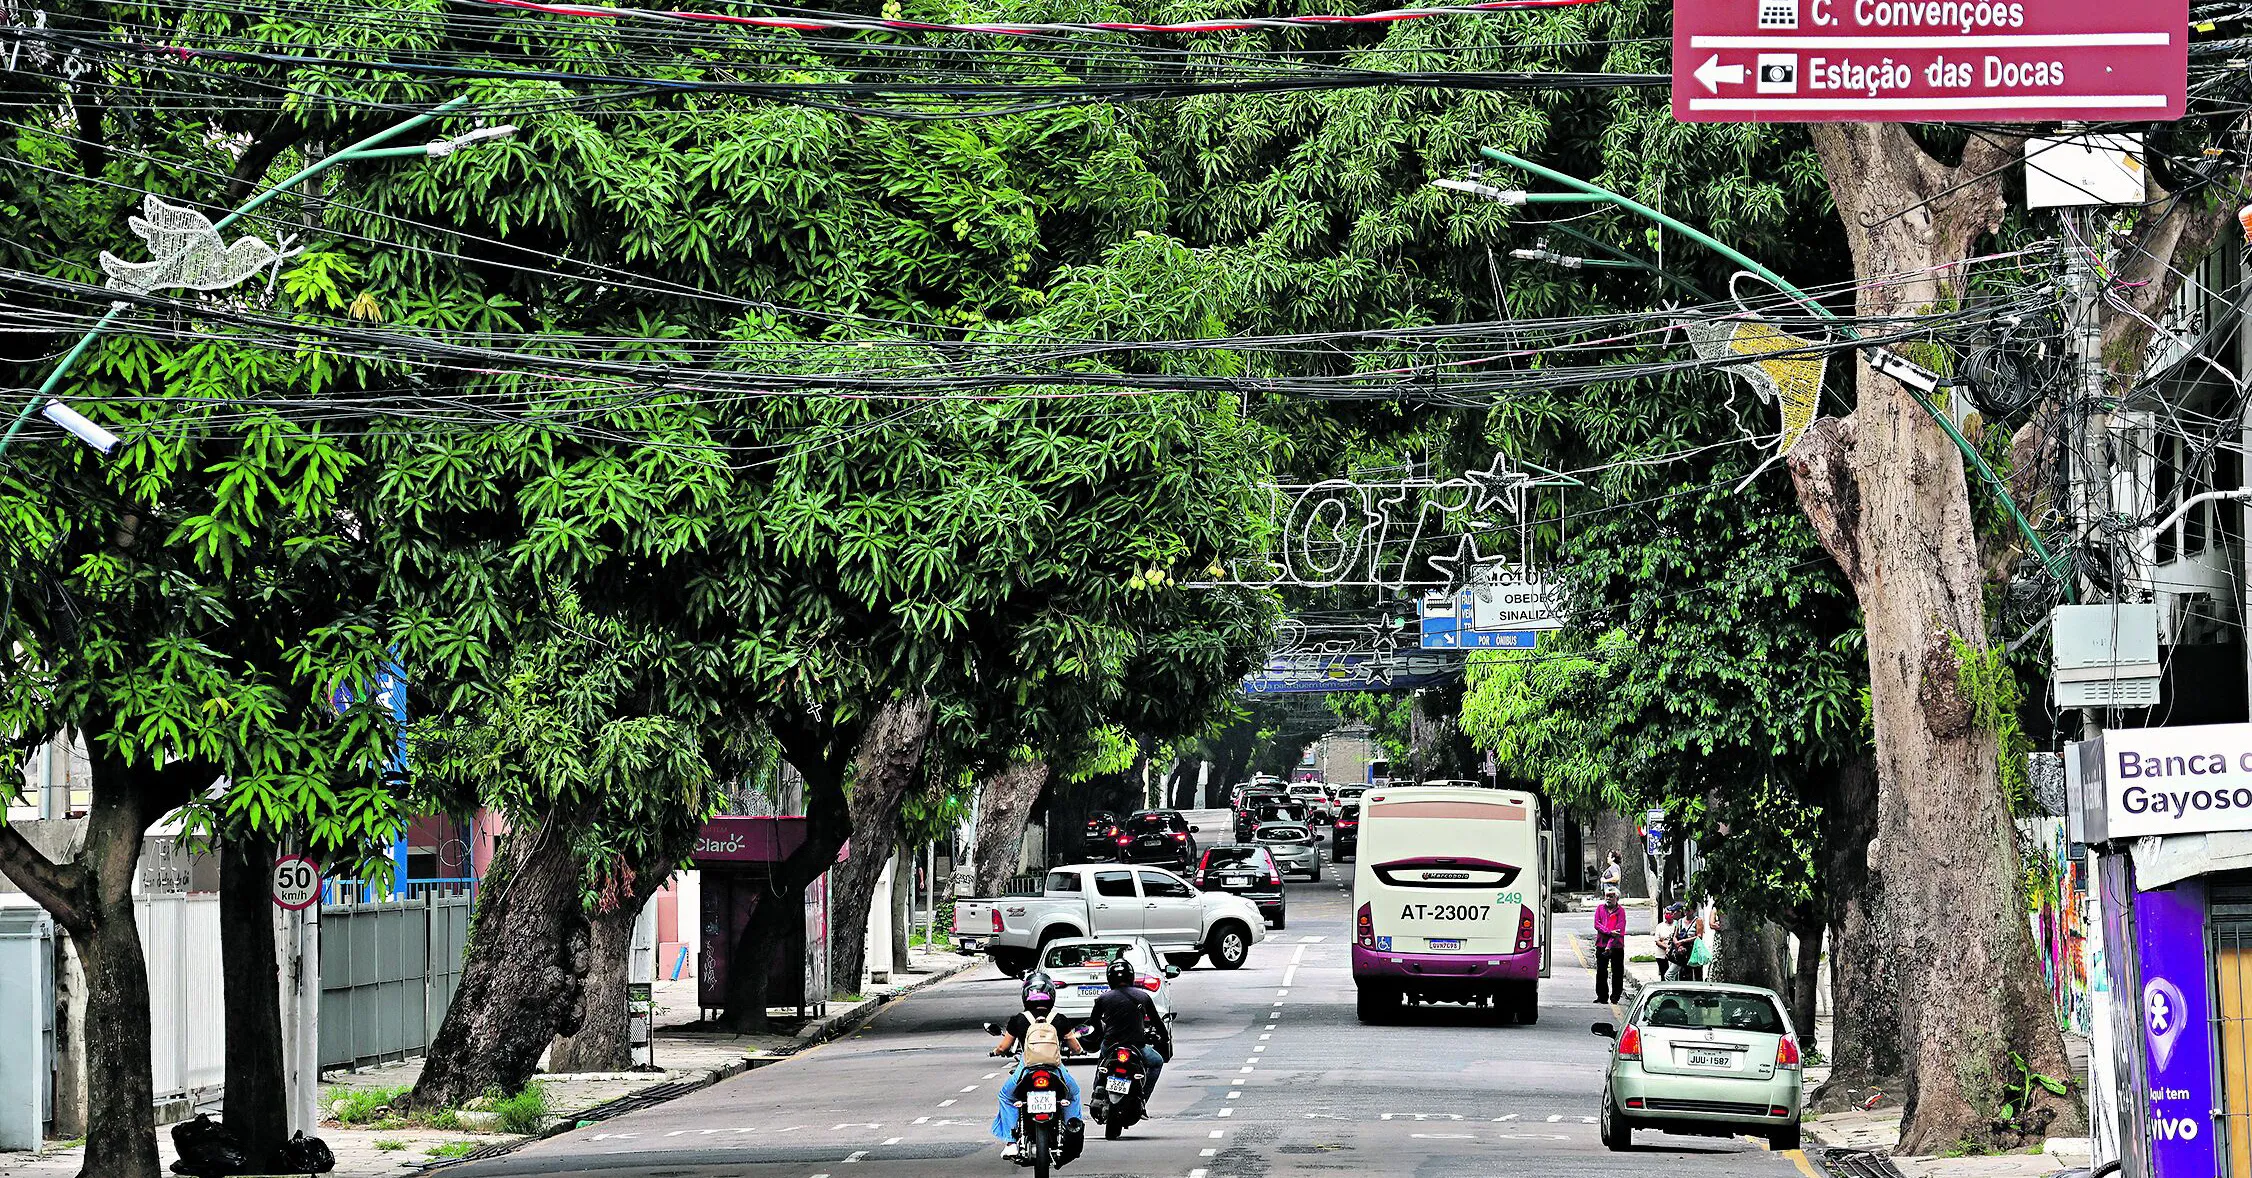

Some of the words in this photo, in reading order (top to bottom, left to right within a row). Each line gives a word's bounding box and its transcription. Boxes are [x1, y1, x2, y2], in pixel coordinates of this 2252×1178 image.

[1811, 0, 1838, 26] C.
[1855, 0, 2024, 33] Convenções
[1810, 56, 1912, 96] Estação
[1927, 55, 1974, 88] das
[1984, 55, 2064, 88] Docas
[1478, 635, 1490, 646] POR
[1495, 632, 1518, 646] ÔNIBUS
[2118, 751, 2227, 779] Banca
[2122, 786, 2252, 819] Gayoso
[278, 867, 310, 889] 50
[281, 890, 307, 900] km/h
[1496, 892, 1522, 904] 249
[1400, 904, 1490, 921] AT-23007
[2165, 1088, 2190, 1100] tem
